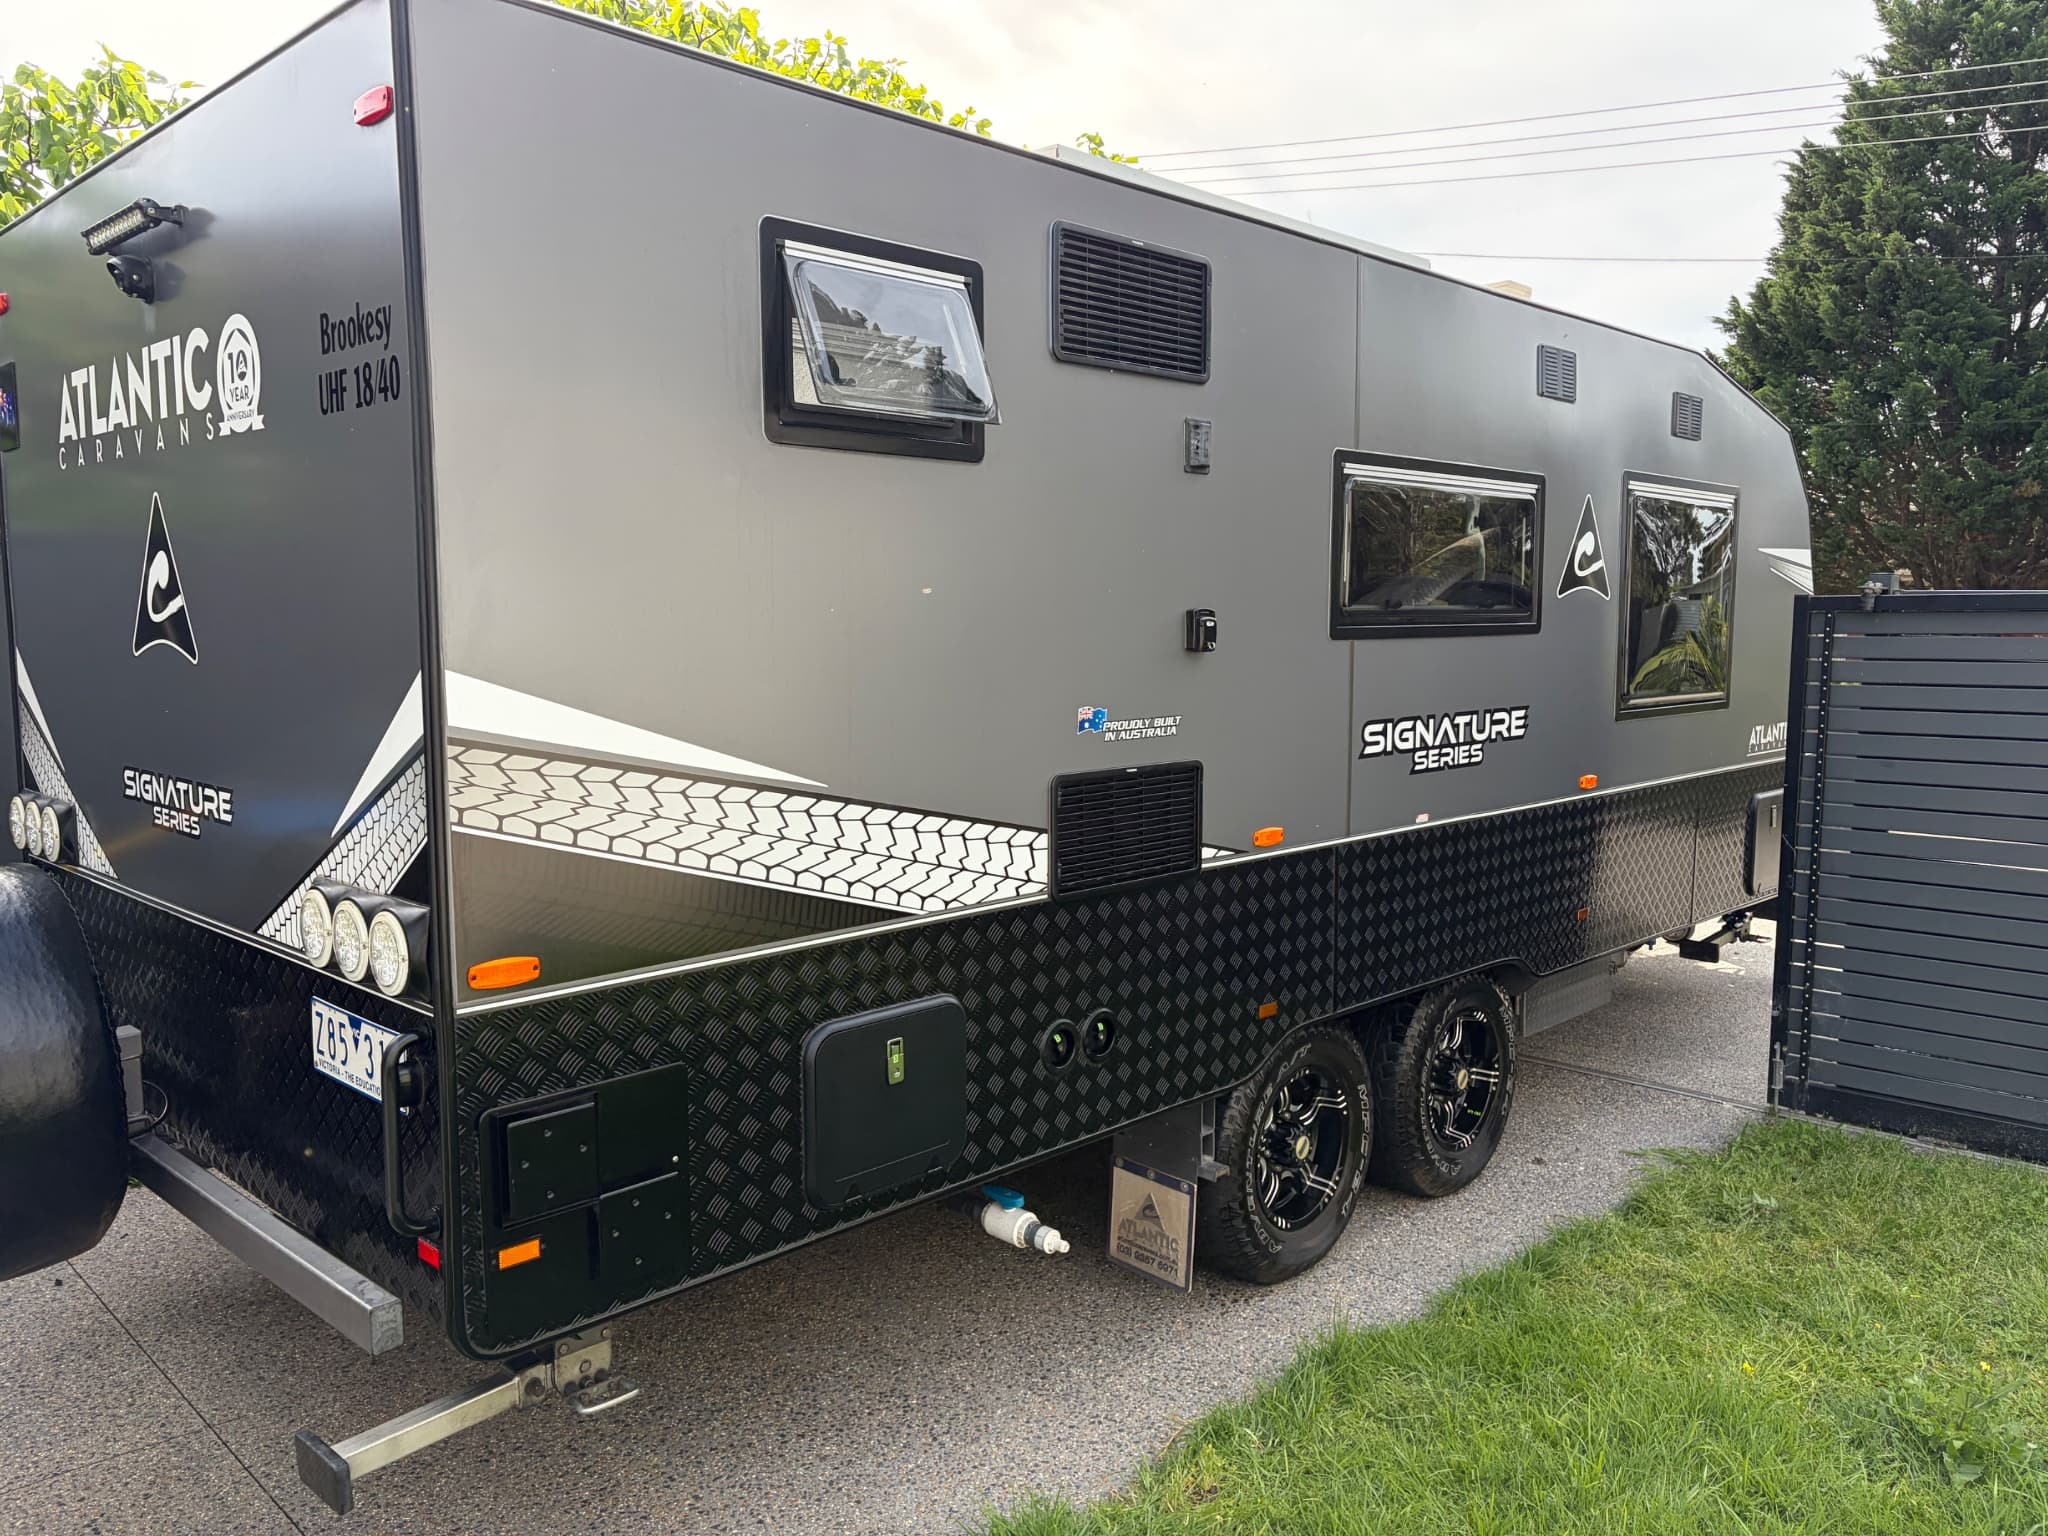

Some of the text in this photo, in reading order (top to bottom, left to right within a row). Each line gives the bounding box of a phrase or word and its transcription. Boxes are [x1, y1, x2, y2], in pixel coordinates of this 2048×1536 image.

[320, 301, 391, 355] Brookesy
[59, 327, 213, 444] ATLANTIC
[229, 385, 249, 402] YEAR
[318, 354, 400, 415] UHF 18/40
[59, 412, 214, 470] CARAVANS
[1103, 716, 1182, 731] PROUDLY BUILT
[1104, 726, 1177, 741] IN AUSTRALIA
[1363, 709, 1527, 755] SIGNATURE
[1749, 721, 1787, 745] ATLANTI
[1414, 743, 1483, 771] SERIES
[124, 769, 233, 822] SIGNATURE
[153, 806, 201, 836] SERIES
[315, 1011, 349, 1066] Z85
[319, 1058, 340, 1074] VICTORIA
[345, 1070, 355, 1083] THE
[355, 1076, 381, 1096] EDUCATIO
